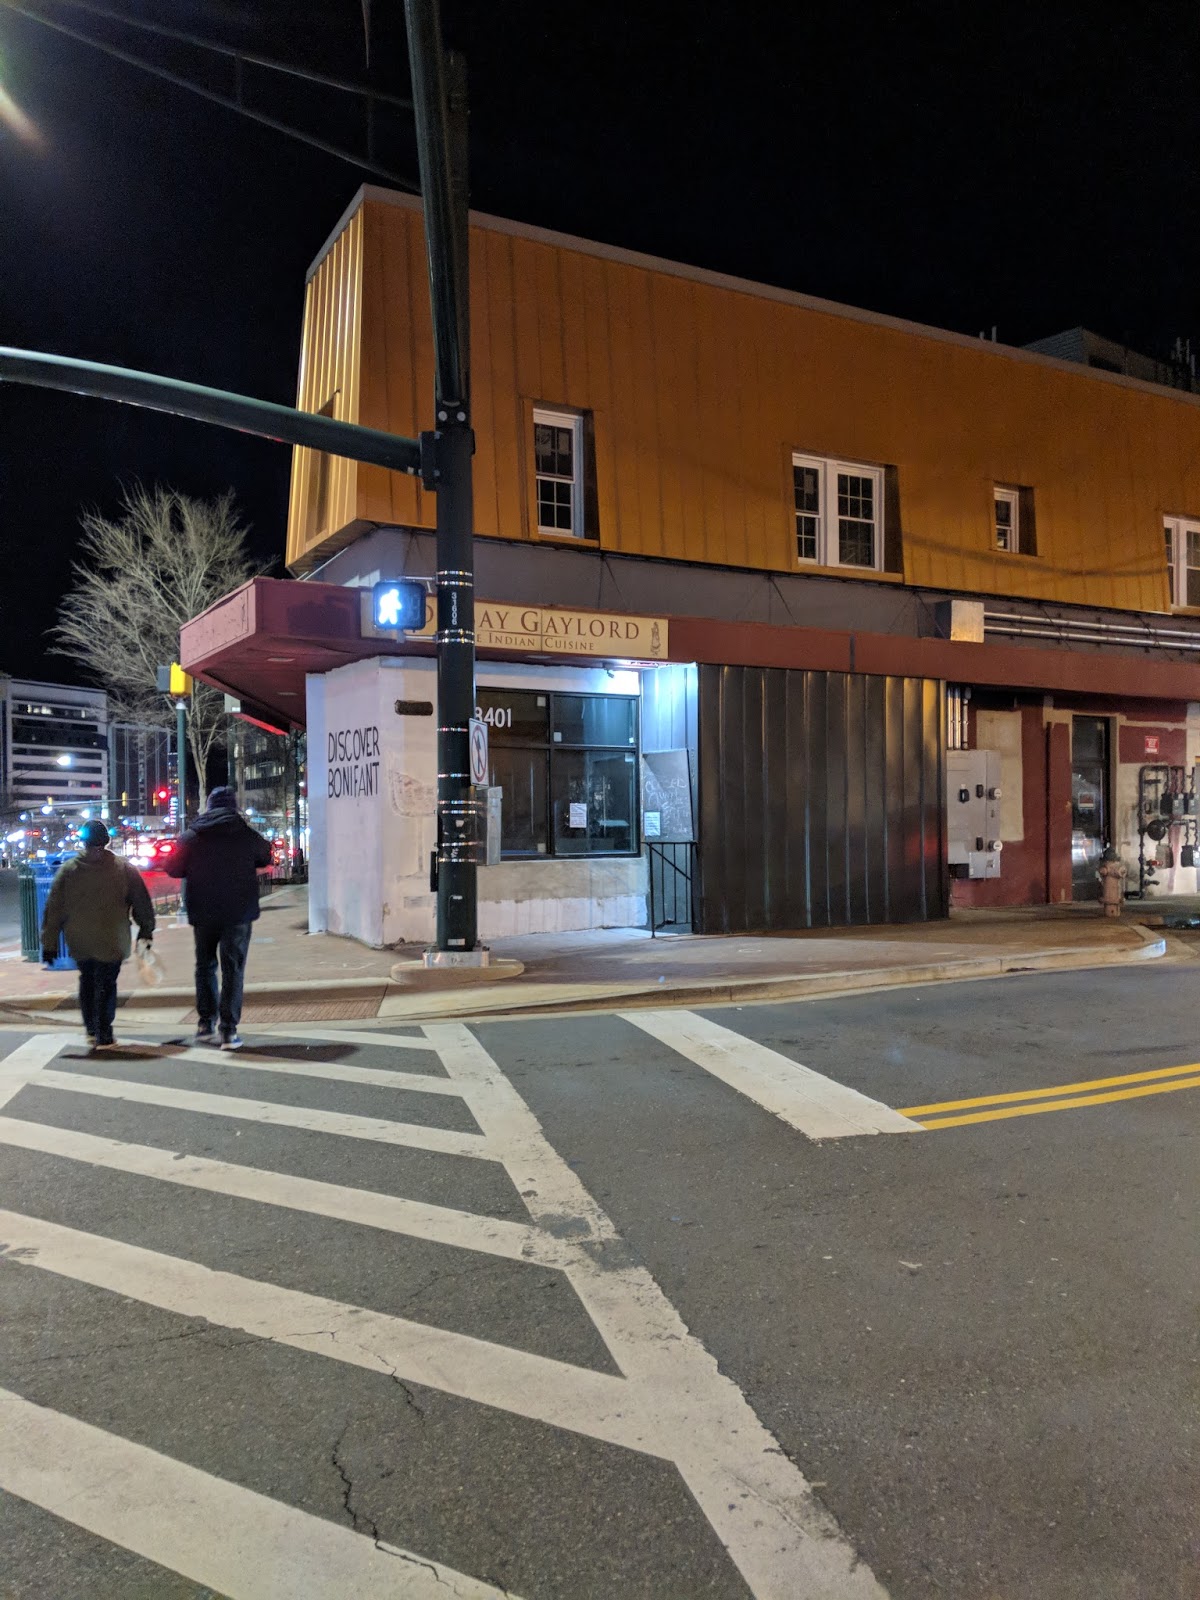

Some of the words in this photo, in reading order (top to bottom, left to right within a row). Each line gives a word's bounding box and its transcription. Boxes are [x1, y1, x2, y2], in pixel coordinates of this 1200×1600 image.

[488, 632, 535, 647] INDIAN
[544, 637, 594, 651] CUISINE
[520, 610, 640, 640] GAYLORD
[328, 726, 380, 763] DISCOVER
[328, 762, 380, 799] BONIFANT
